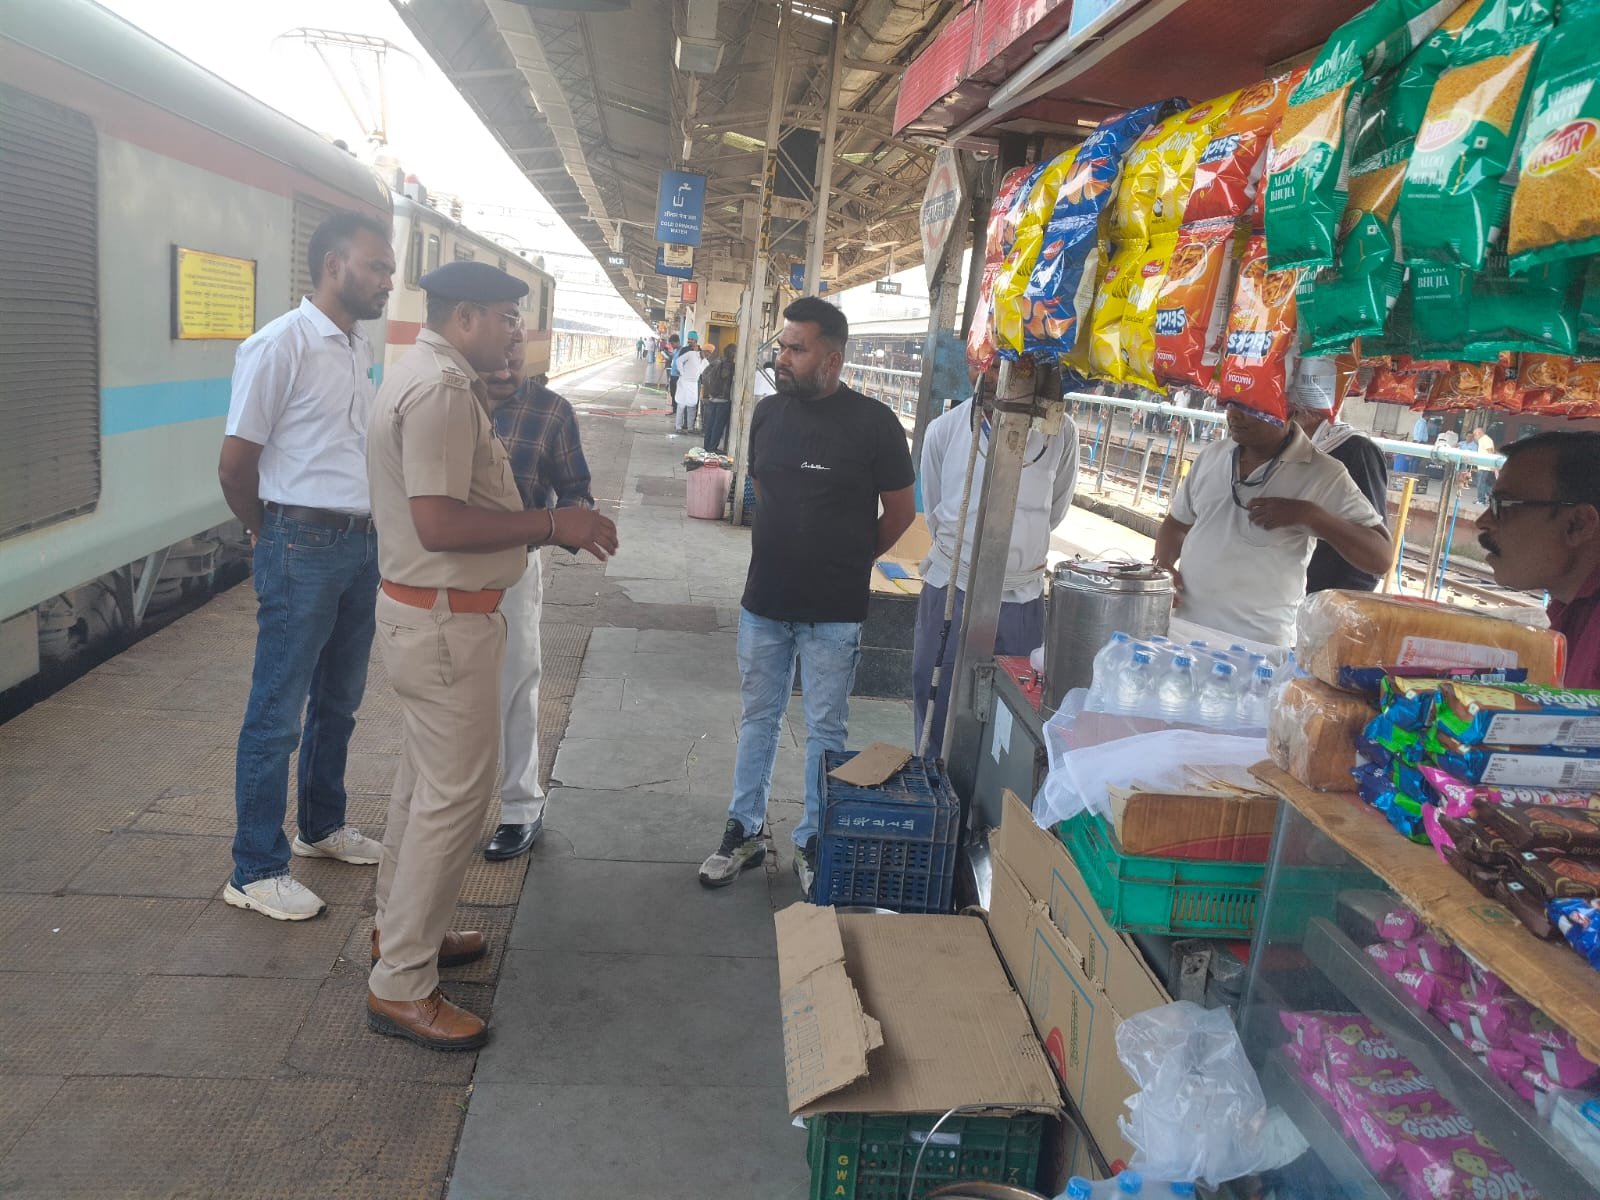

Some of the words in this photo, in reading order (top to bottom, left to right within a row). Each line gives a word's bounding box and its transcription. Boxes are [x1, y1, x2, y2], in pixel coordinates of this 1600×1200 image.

[1273, 173, 1295, 187] ALOO
[1270, 186, 1296, 202] BHUJIA
[670, 228, 688, 236] WATER
[1417, 275, 1449, 288] BHUJIA
[1227, 330, 1273, 354] Sticks
[1228, 374, 1251, 385] NAKODA
